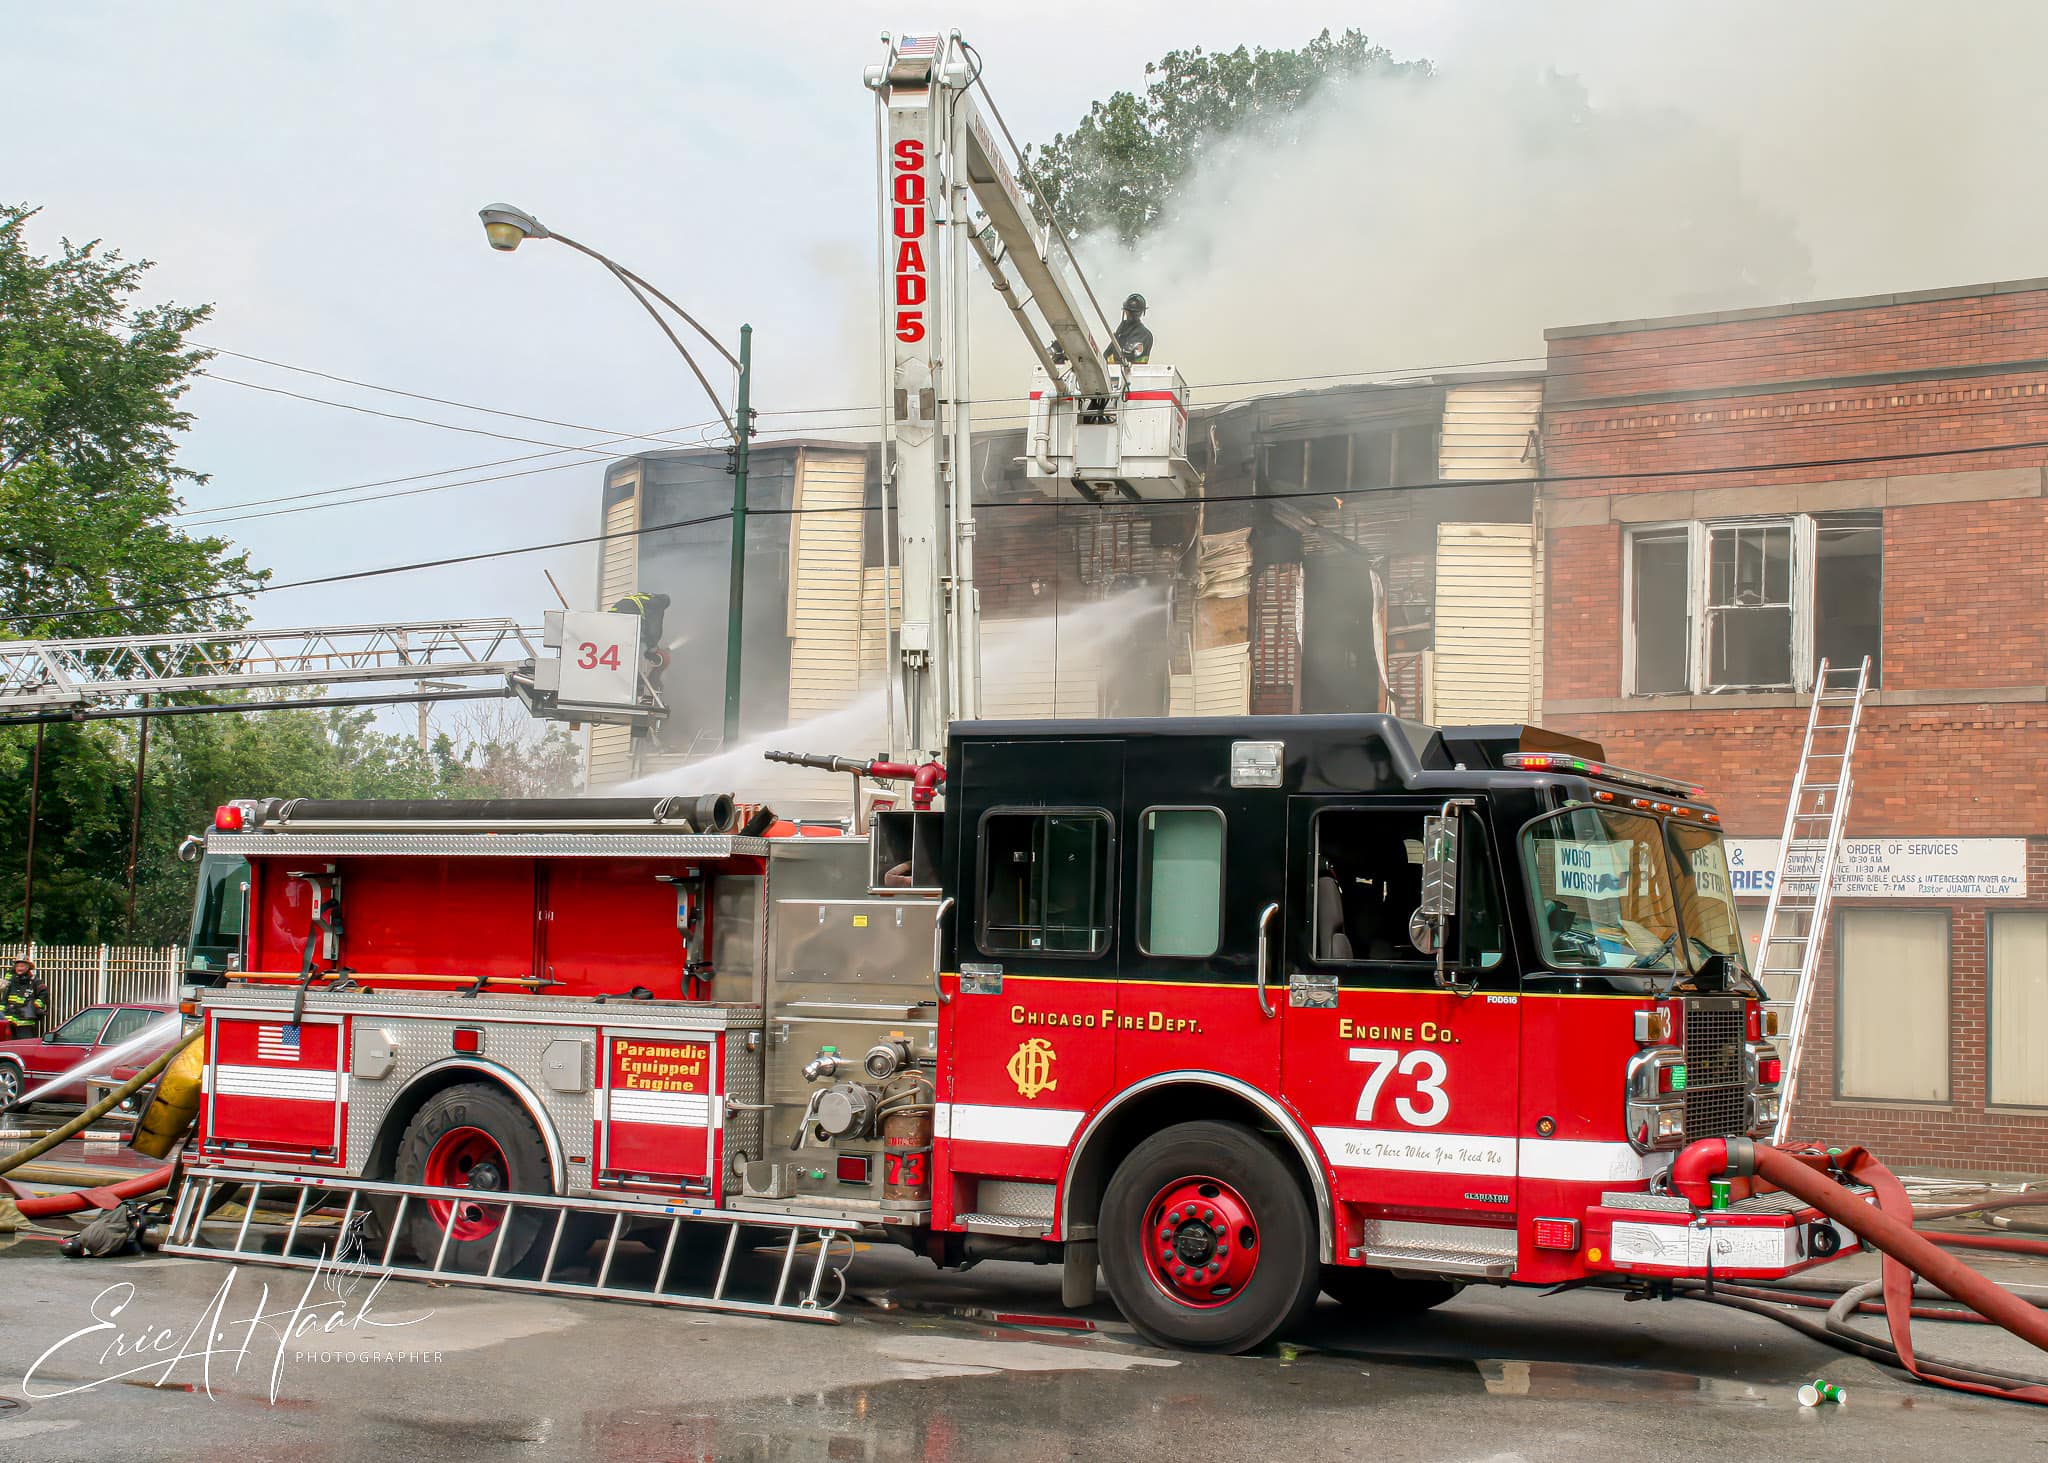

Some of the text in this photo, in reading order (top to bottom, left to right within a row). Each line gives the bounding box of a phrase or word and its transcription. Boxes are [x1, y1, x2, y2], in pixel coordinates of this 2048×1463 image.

[894, 139, 927, 343] SQUAD 5
[577, 642, 621, 671] 34
[1561, 848, 1591, 868] WORD
[1731, 848, 1745, 865] &
[1846, 844, 1959, 855] ORDER OF SERVICES
[1787, 855, 1813, 864] SUNDAY
[1788, 865, 1815, 873] SUNDAY
[1877, 865, 1890, 873] AM
[1561, 870, 1601, 894] WORSH
[1788, 883, 1816, 892] FRIDAY
[1846, 884, 1878, 892] SERVICE
[1867, 875, 1888, 883] BIBLE
[1891, 875, 1916, 883] CLASS
[1918, 884, 2010, 894] Pastor JUANITA CLAY
[616, 1041, 707, 1060] Paramedic
[621, 1057, 700, 1077] Equipped
[626, 1074, 694, 1092] Engine
[1349, 1047, 1450, 1127] 73
[1345, 1142, 1502, 1166] We're There When You Need Us
[885, 1153, 925, 1185] 73
